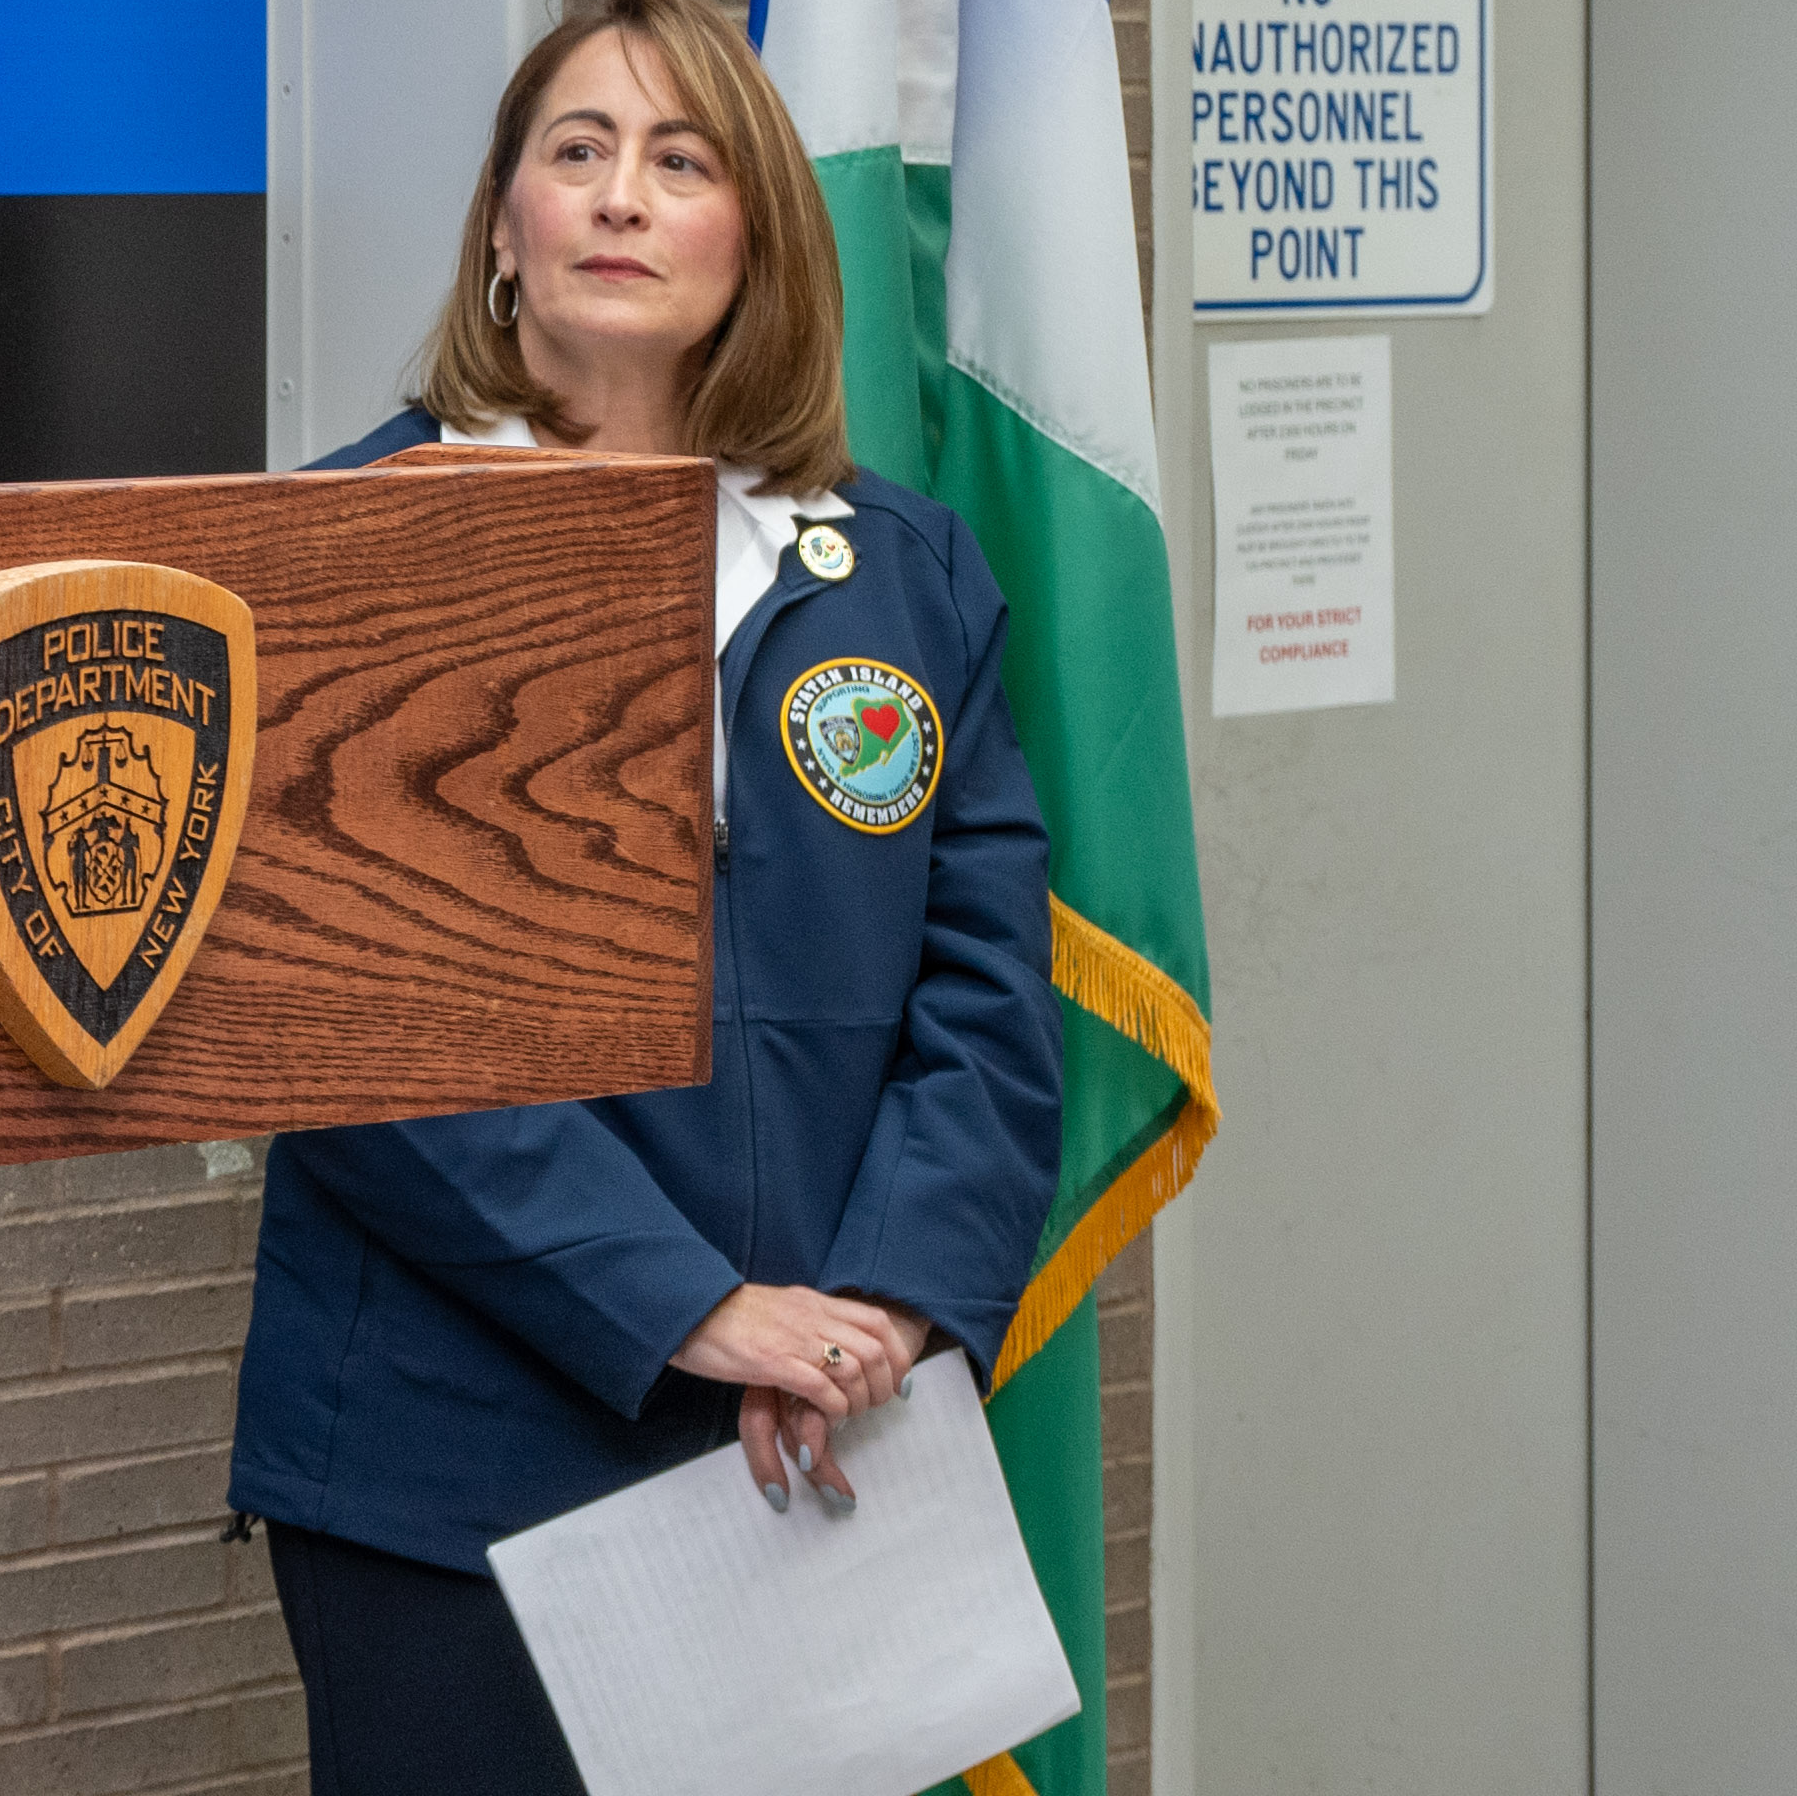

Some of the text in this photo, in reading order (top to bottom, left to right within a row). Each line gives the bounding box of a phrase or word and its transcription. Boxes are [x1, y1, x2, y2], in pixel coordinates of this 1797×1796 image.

[1193, 20, 1459, 76] NAUTHORIZED
[1192, 90, 1424, 144] PERSONNEL
[1354, 156, 1439, 211] THIS
[1251, 227, 1365, 281] POINT
[43, 620, 165, 671] POLICE
[1247, 605, 1362, 634] FOR YOUR STRICT
[1259, 638, 1349, 664] COMPLIANCE
[790, 666, 923, 724] STATEN ISLAND
[829, 782, 924, 825] REMEMBERS
[139, 761, 221, 969] NEW YORK
[23, 907, 65, 961] OF
